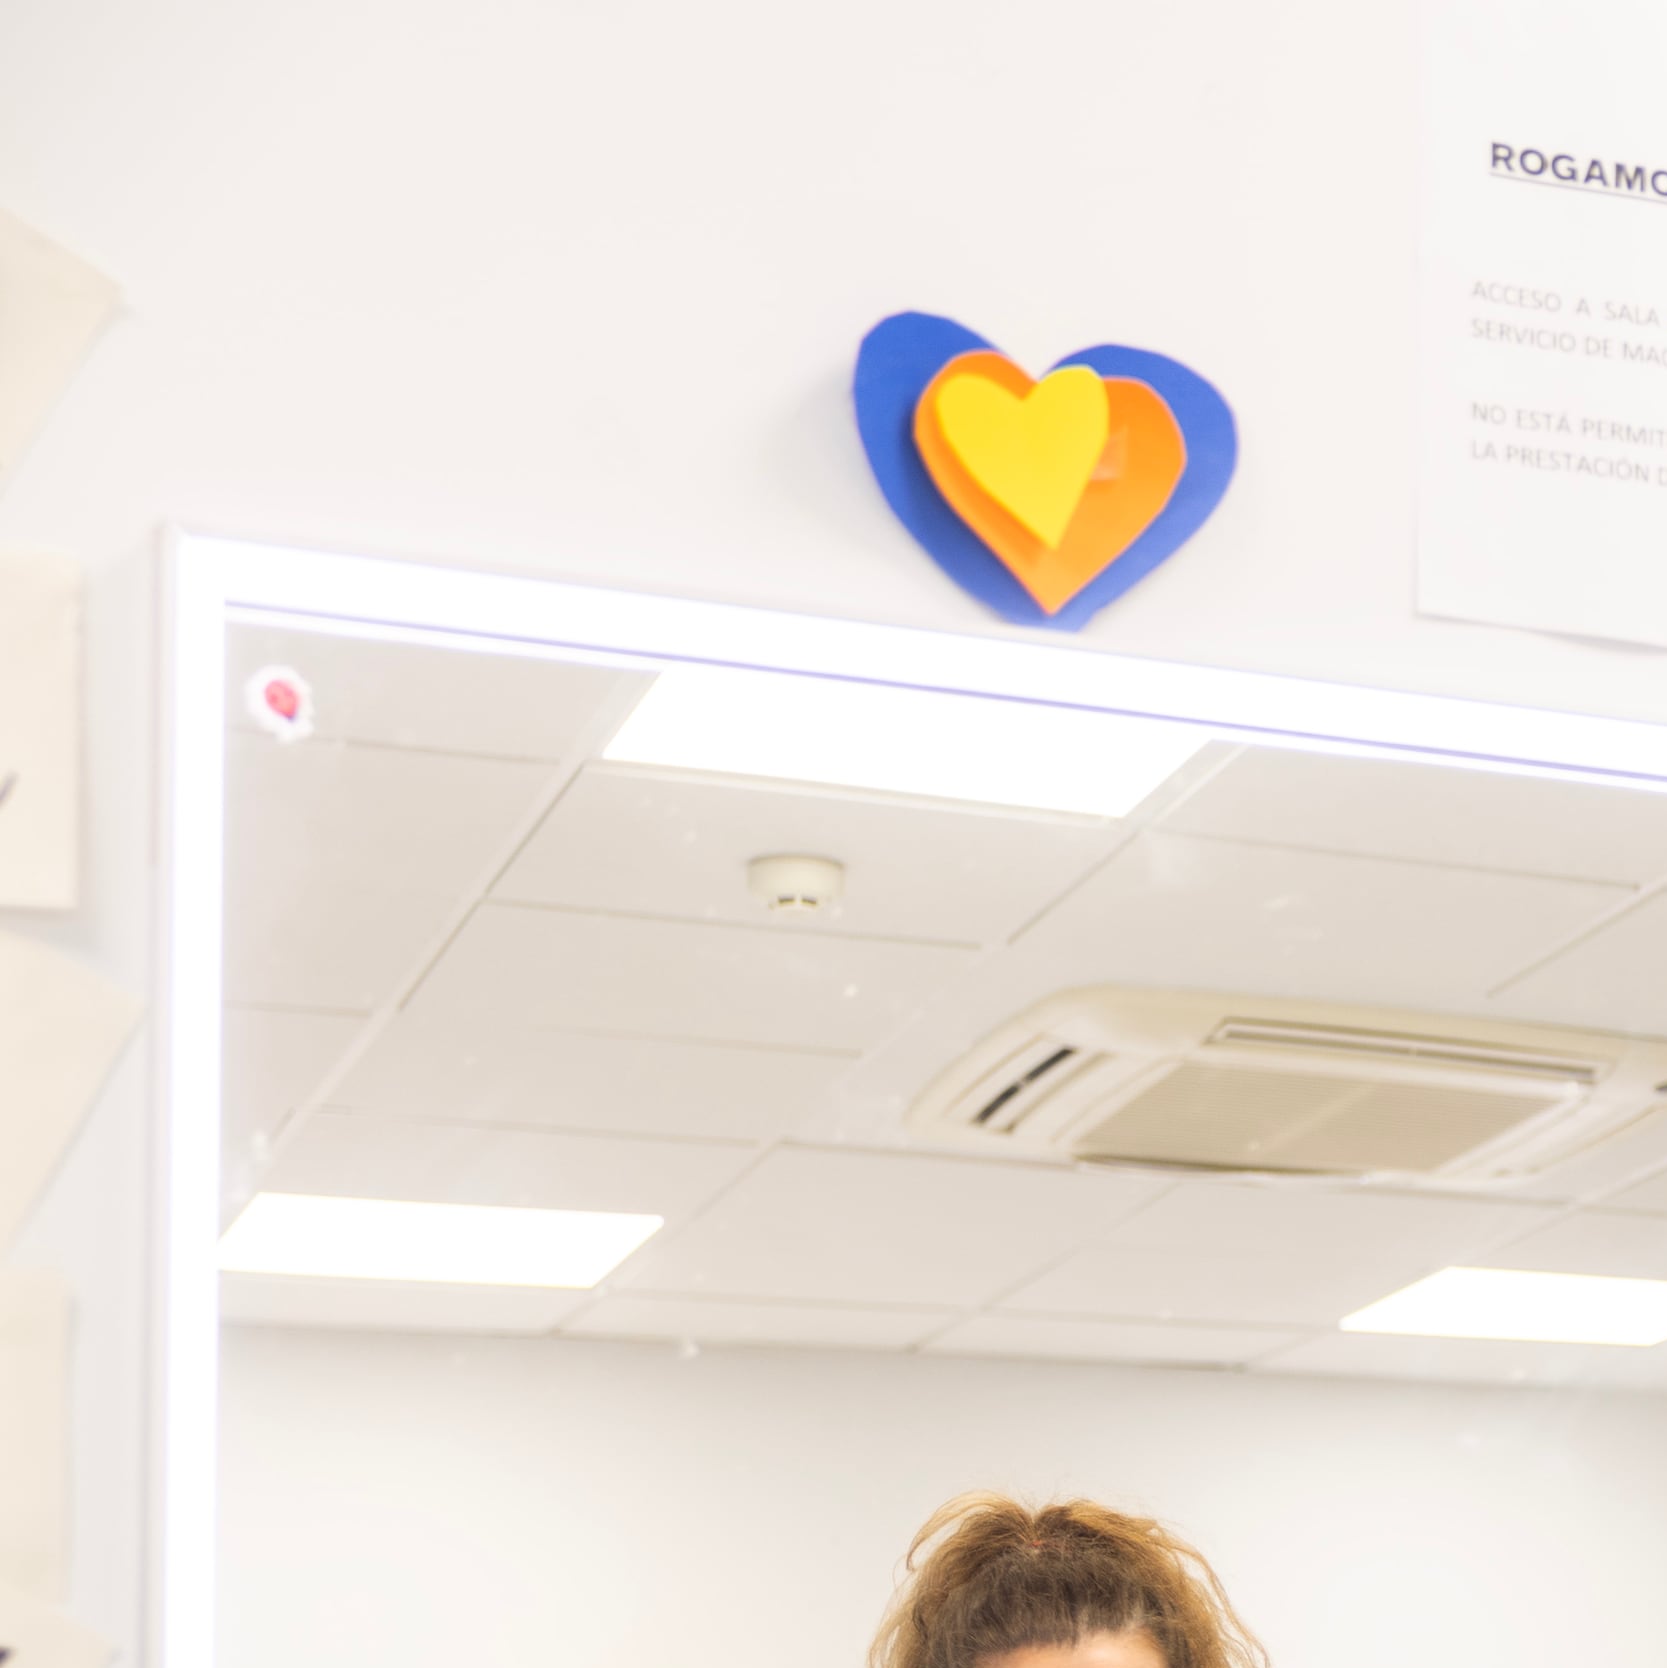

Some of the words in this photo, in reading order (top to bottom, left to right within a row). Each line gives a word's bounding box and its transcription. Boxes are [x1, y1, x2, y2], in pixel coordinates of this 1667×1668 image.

[1470, 280, 1562, 313] ACCESO
[1576, 297, 1591, 318] A
[1604, 301, 1661, 328] SALA
[1470, 317, 1576, 352] SERVICIO
[1585, 335, 1614, 359] DE
[1470, 402, 1507, 426] NO
[1515, 407, 1572, 435] ESTÁ
[1470, 440, 1498, 462] LA
[1505, 444, 1650, 484] PRESTACIÓN
